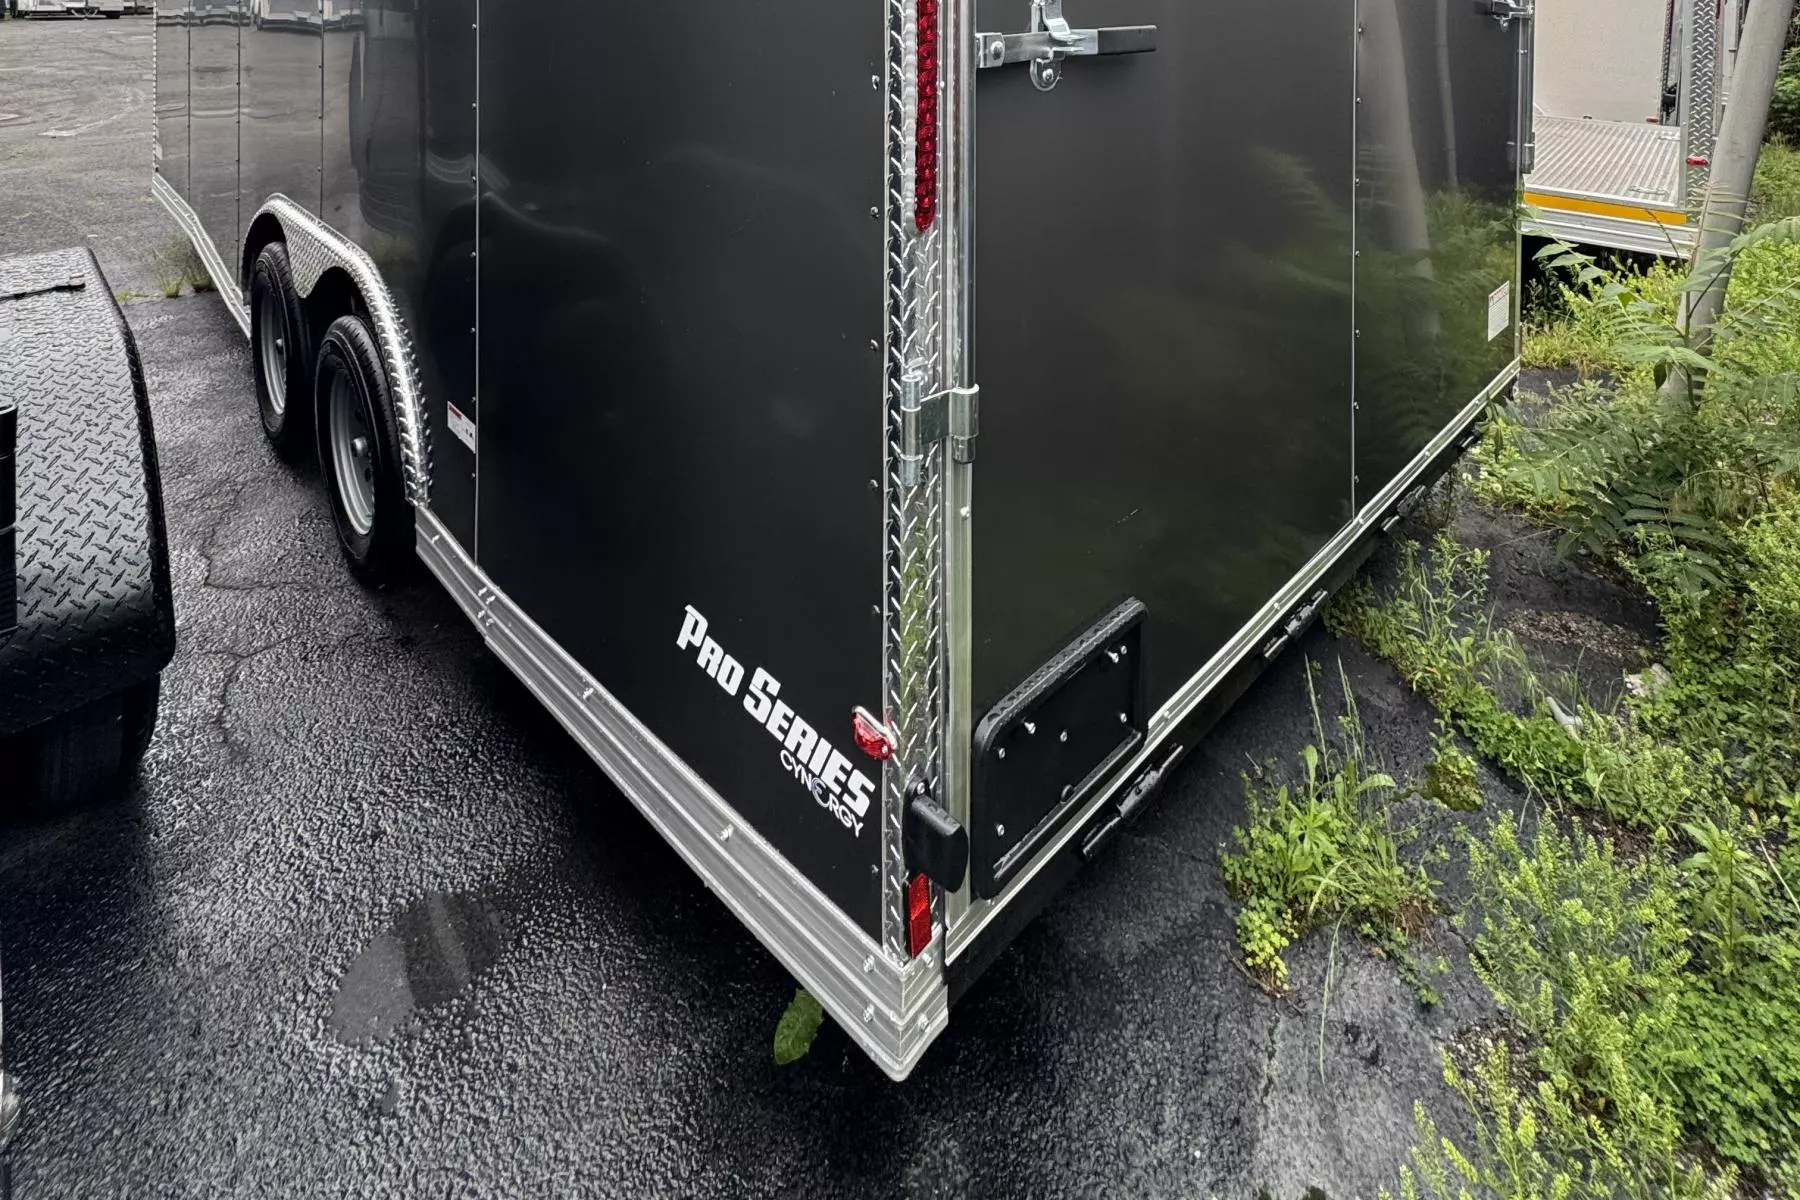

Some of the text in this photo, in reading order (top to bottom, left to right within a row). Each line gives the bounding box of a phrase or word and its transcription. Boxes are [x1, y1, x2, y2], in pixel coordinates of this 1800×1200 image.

[676, 604, 876, 818] PRO SERIES
[779, 749, 864, 839] CYNERGY
